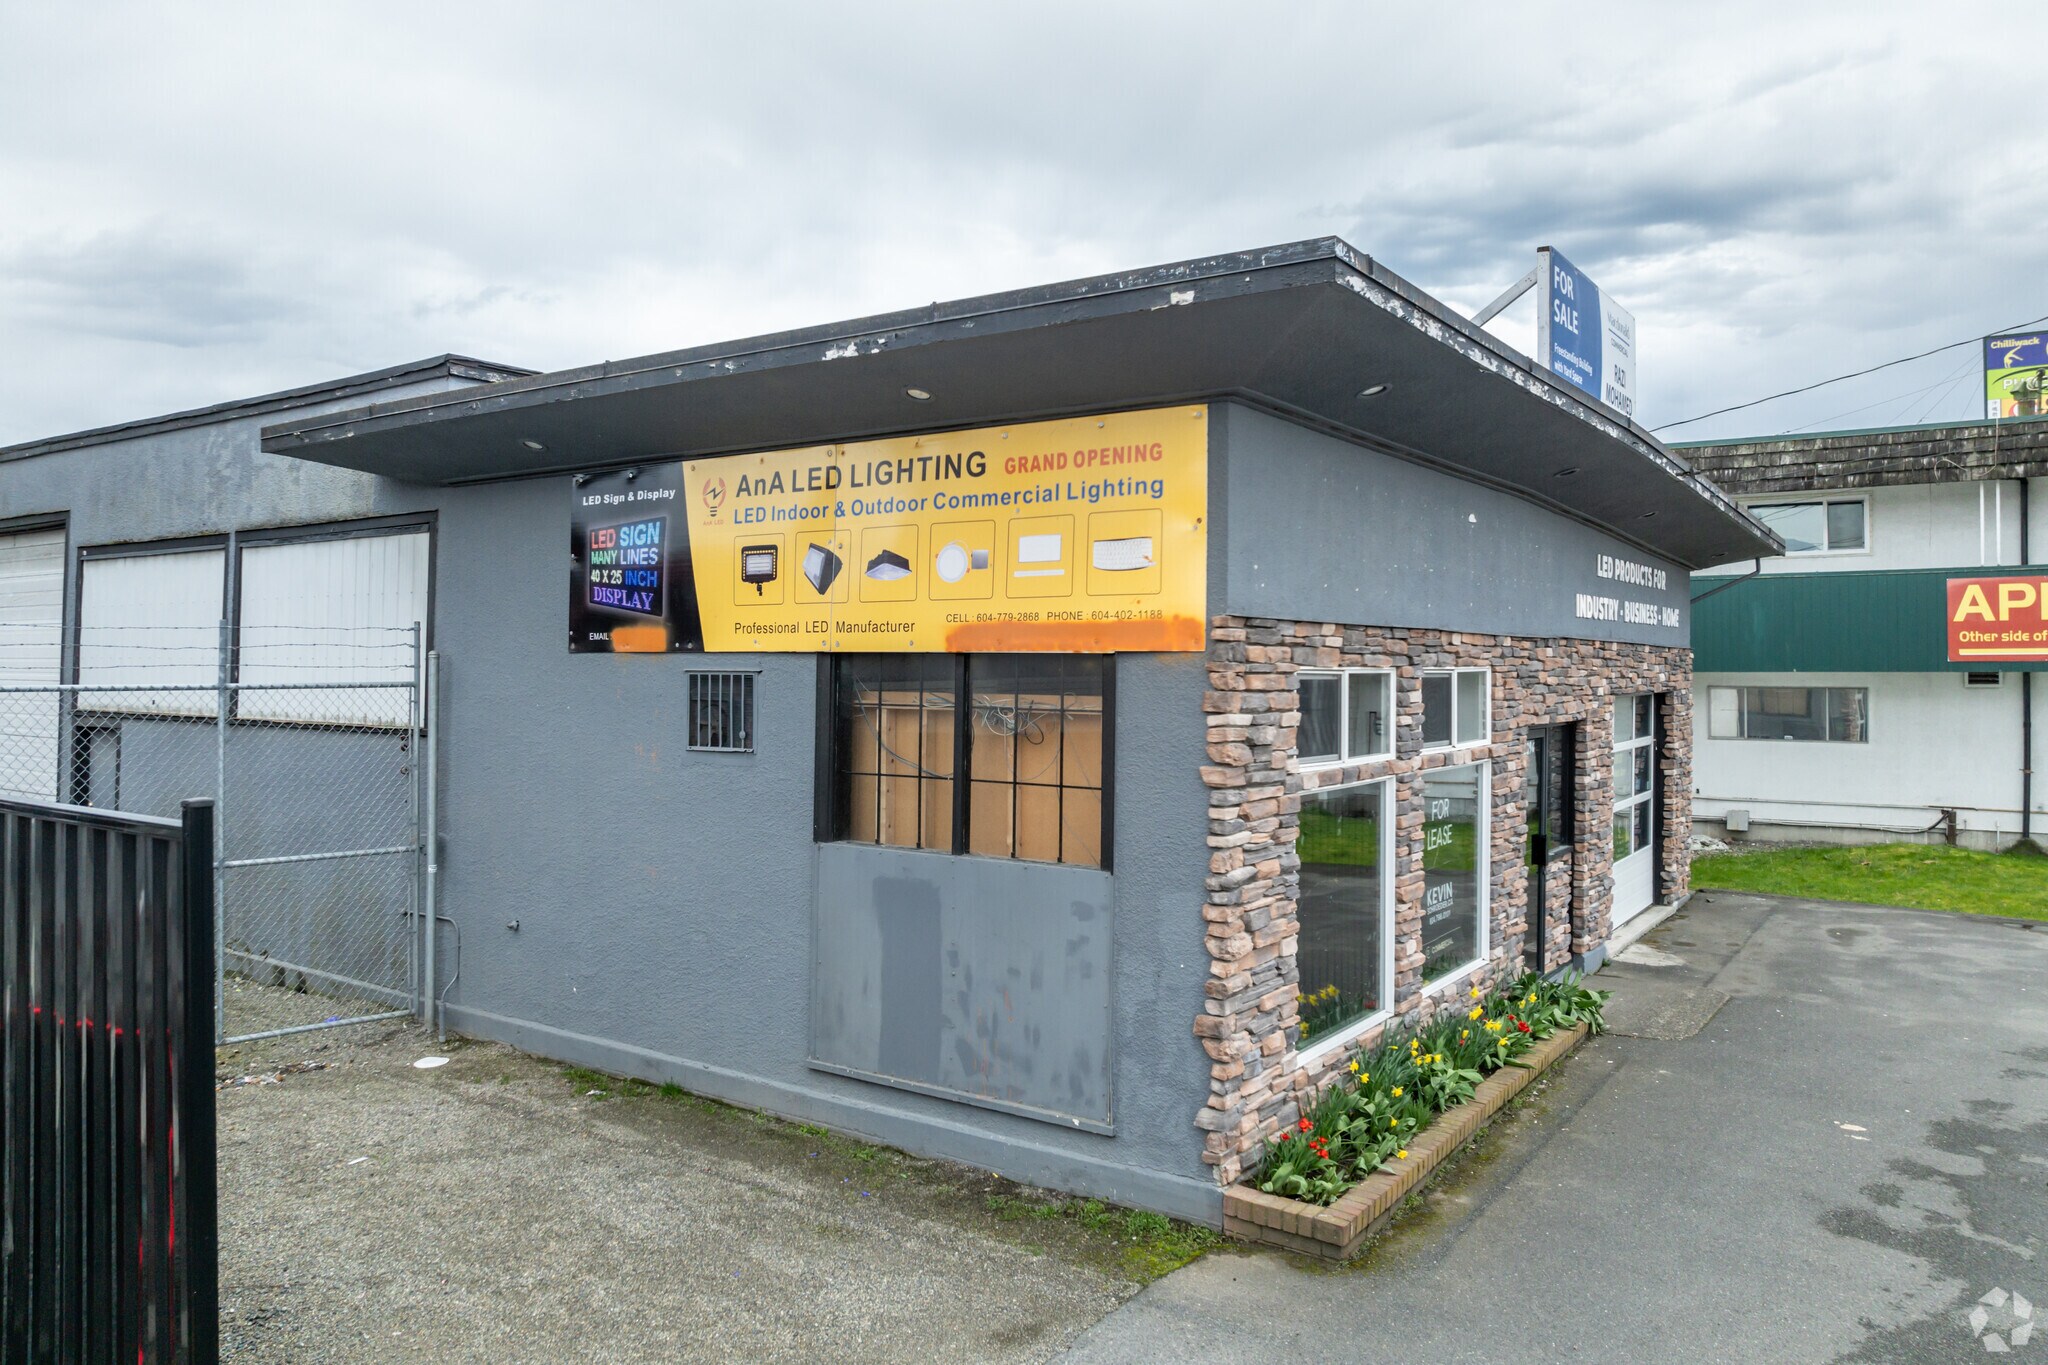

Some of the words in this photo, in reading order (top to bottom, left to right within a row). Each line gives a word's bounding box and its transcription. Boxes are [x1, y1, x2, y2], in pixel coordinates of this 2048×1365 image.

[1554, 266, 1574, 300] FOR
[1554, 299, 1578, 335] SALE
[1991, 337, 2040, 349] Chilliwack
[1614, 364, 1627, 388] RAZI
[1606, 382, 1633, 417] MOHAMED
[1004, 452, 1068, 475] GRAND
[1074, 442, 1163, 469] OPENING
[736, 471, 784, 497] AnA
[792, 465, 842, 493] LED
[850, 451, 987, 488] LIGHTING
[583, 495, 600, 506] LED
[603, 493, 625, 506] Sign
[627, 492, 634, 501] &
[637, 488, 676, 502] Display
[734, 507, 767, 524] LED
[771, 502, 829, 522] Indoor
[834, 502, 846, 518] &
[851, 494, 928, 516] Outdoor
[934, 483, 1060, 510] Commercial
[1067, 478, 1164, 503] Lighting
[591, 529, 616, 549] LED
[620, 522, 660, 547] SIGN
[591, 550, 617, 565] MANY
[621, 548, 658, 565] LINES
[591, 569, 600, 583] 40
[602, 570, 609, 584] X
[610, 570, 623, 584] 25
[625, 571, 657, 588] INCH
[1597, 554, 1613, 579] LED
[1615, 559, 1652, 588] PRODUCTS
[1654, 569, 1666, 590] FOR
[593, 586, 654, 610] DISPLAY
[1576, 594, 1619, 621] INDUSTRY
[1624, 601, 1657, 625] BUSINESS
[1662, 607, 1679, 627] HOME
[1953, 582, 2048, 622] AP
[735, 622, 800, 634] Professional
[805, 621, 828, 633] LED
[835, 619, 915, 635] Manufacturer
[976, 611, 1039, 622] 604-779-2868
[1091, 610, 1163, 620] 604-402-1188
[589, 632, 609, 640] EMAIL
[1959, 631, 1998, 642] Other
[2001, 630, 2030, 641] side
[2033, 630, 2048, 641] of
[1432, 799, 1449, 821] FOR
[1427, 824, 1452, 851] LEASE
[1427, 882, 1452, 907] KEVIN
